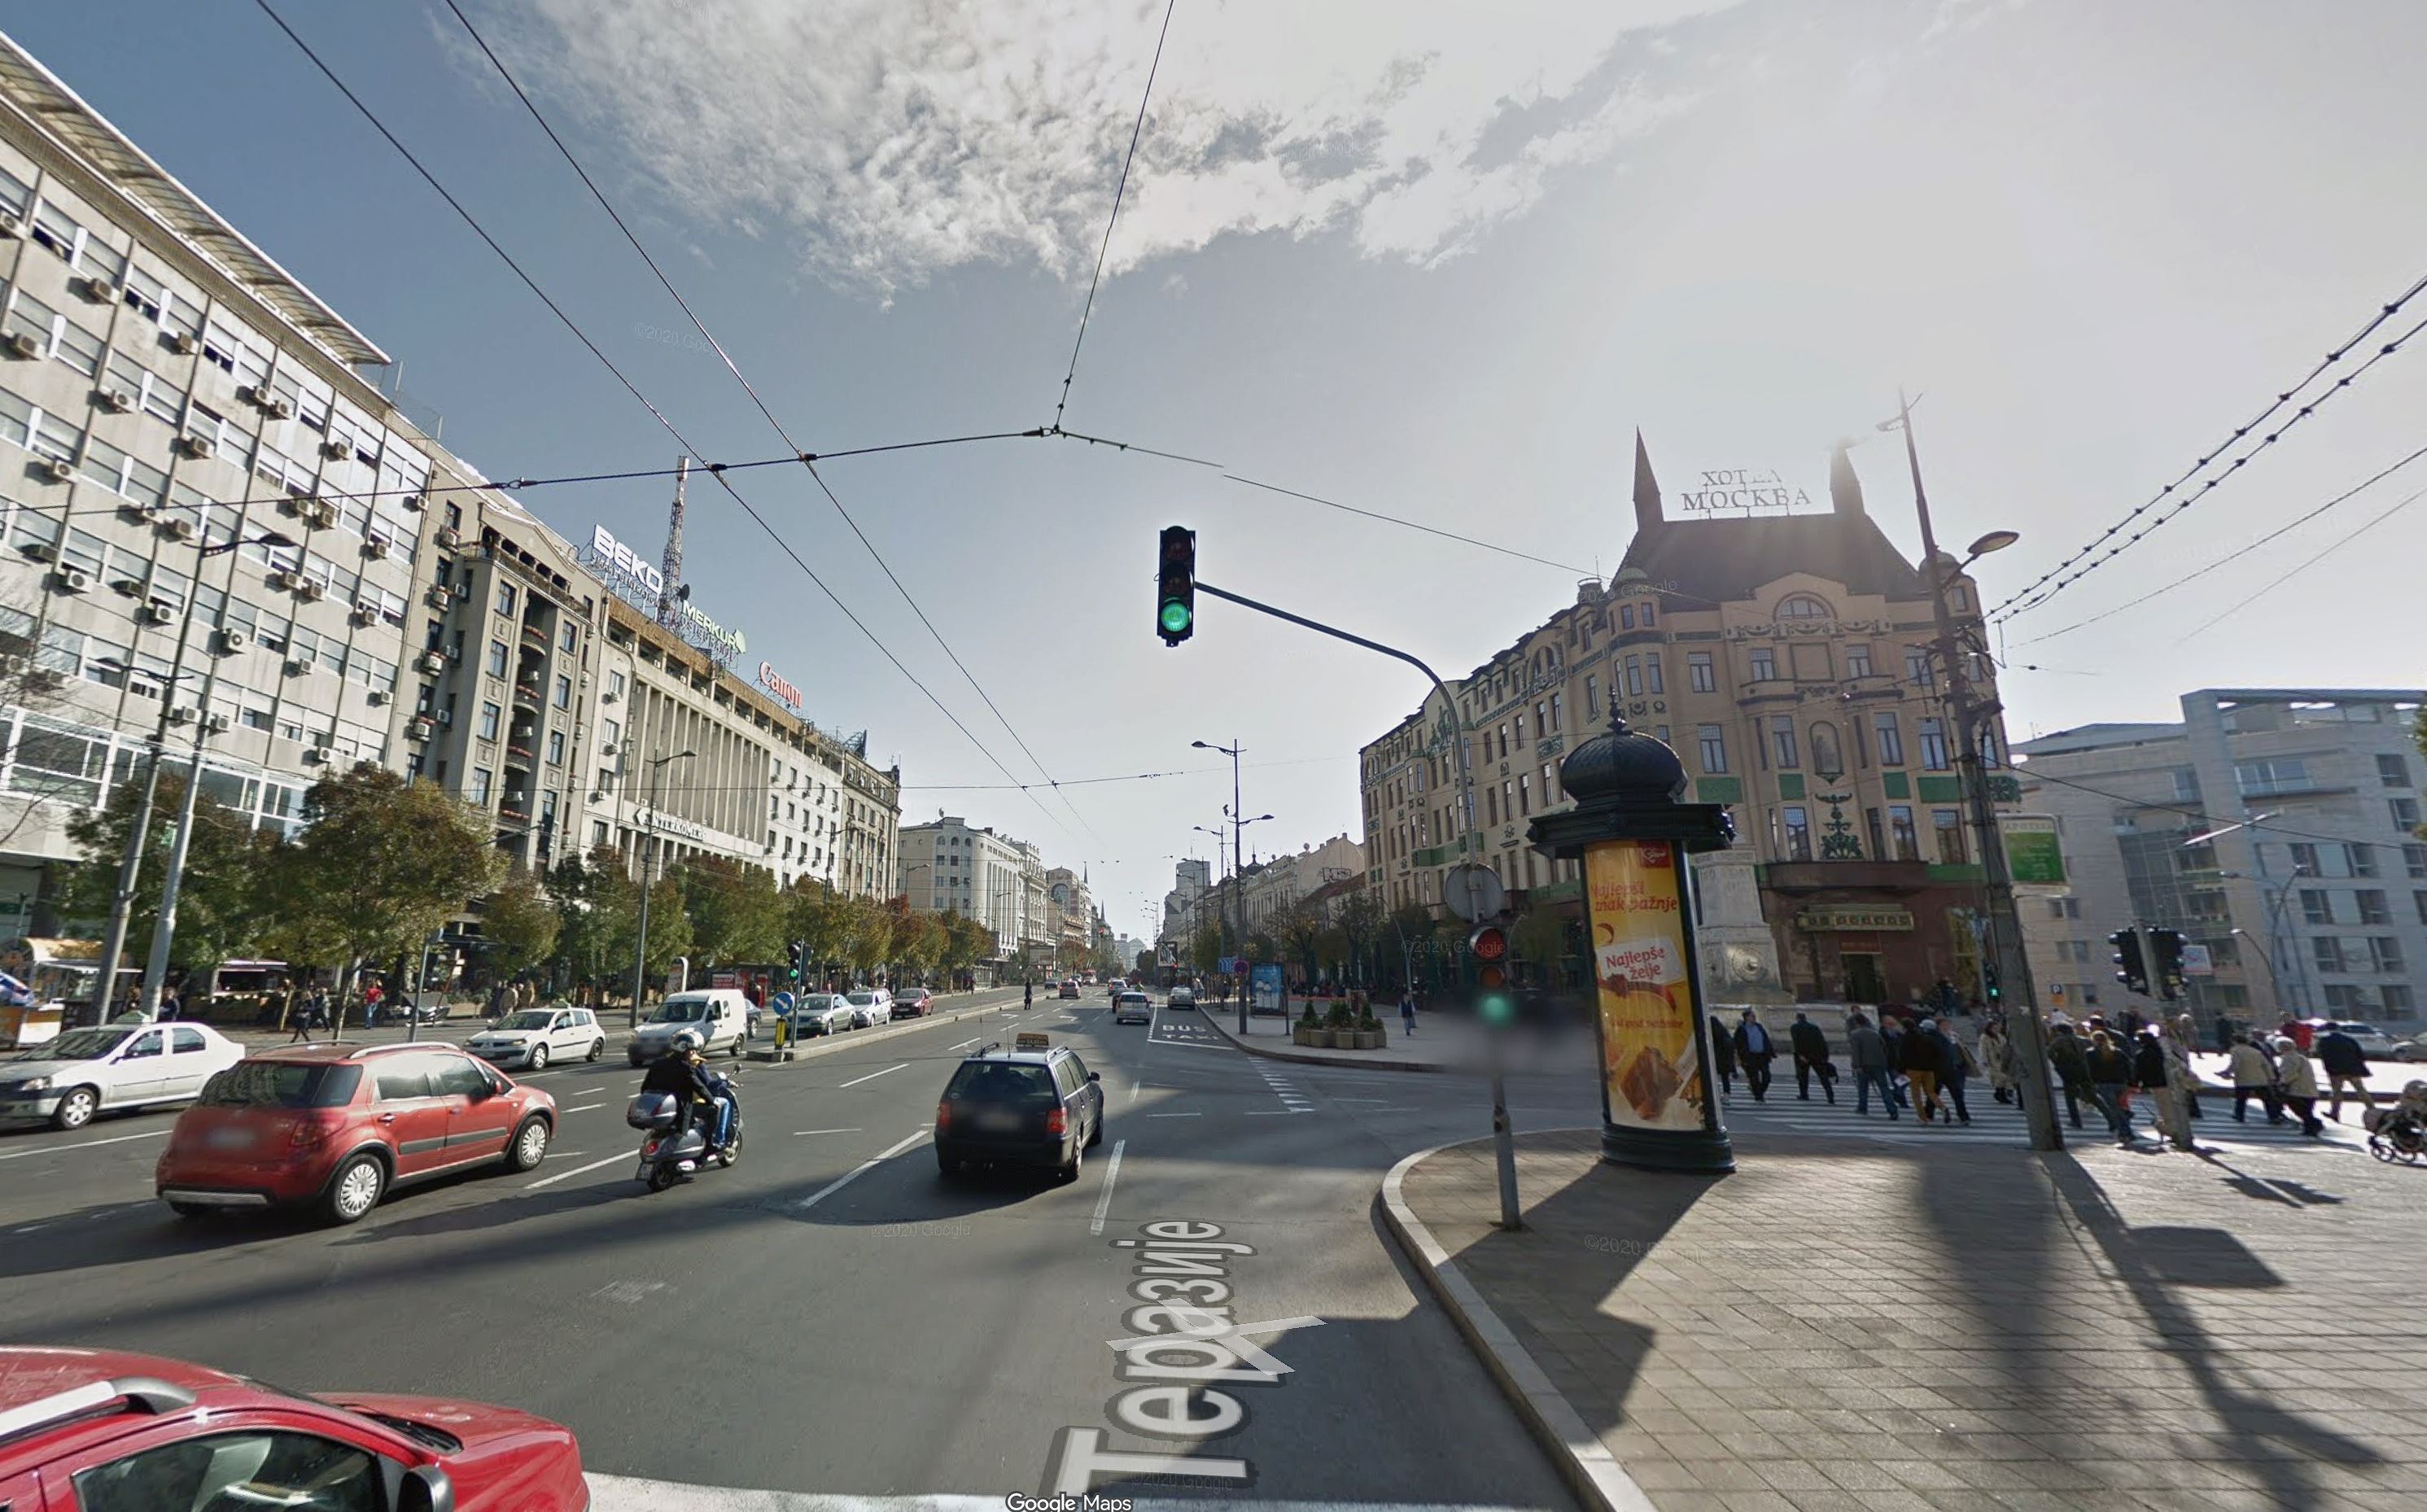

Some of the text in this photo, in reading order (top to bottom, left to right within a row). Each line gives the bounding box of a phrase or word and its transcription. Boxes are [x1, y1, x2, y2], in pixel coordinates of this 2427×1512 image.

[1681, 488, 1812, 510] МОСКВА
[593, 523, 664, 595] BEKO
[683, 599, 737, 649] MERKUR
[759, 660, 803, 710] Canon
[1606, 946, 1666, 969] Najlepše
[1628, 964, 1662, 981] želje
